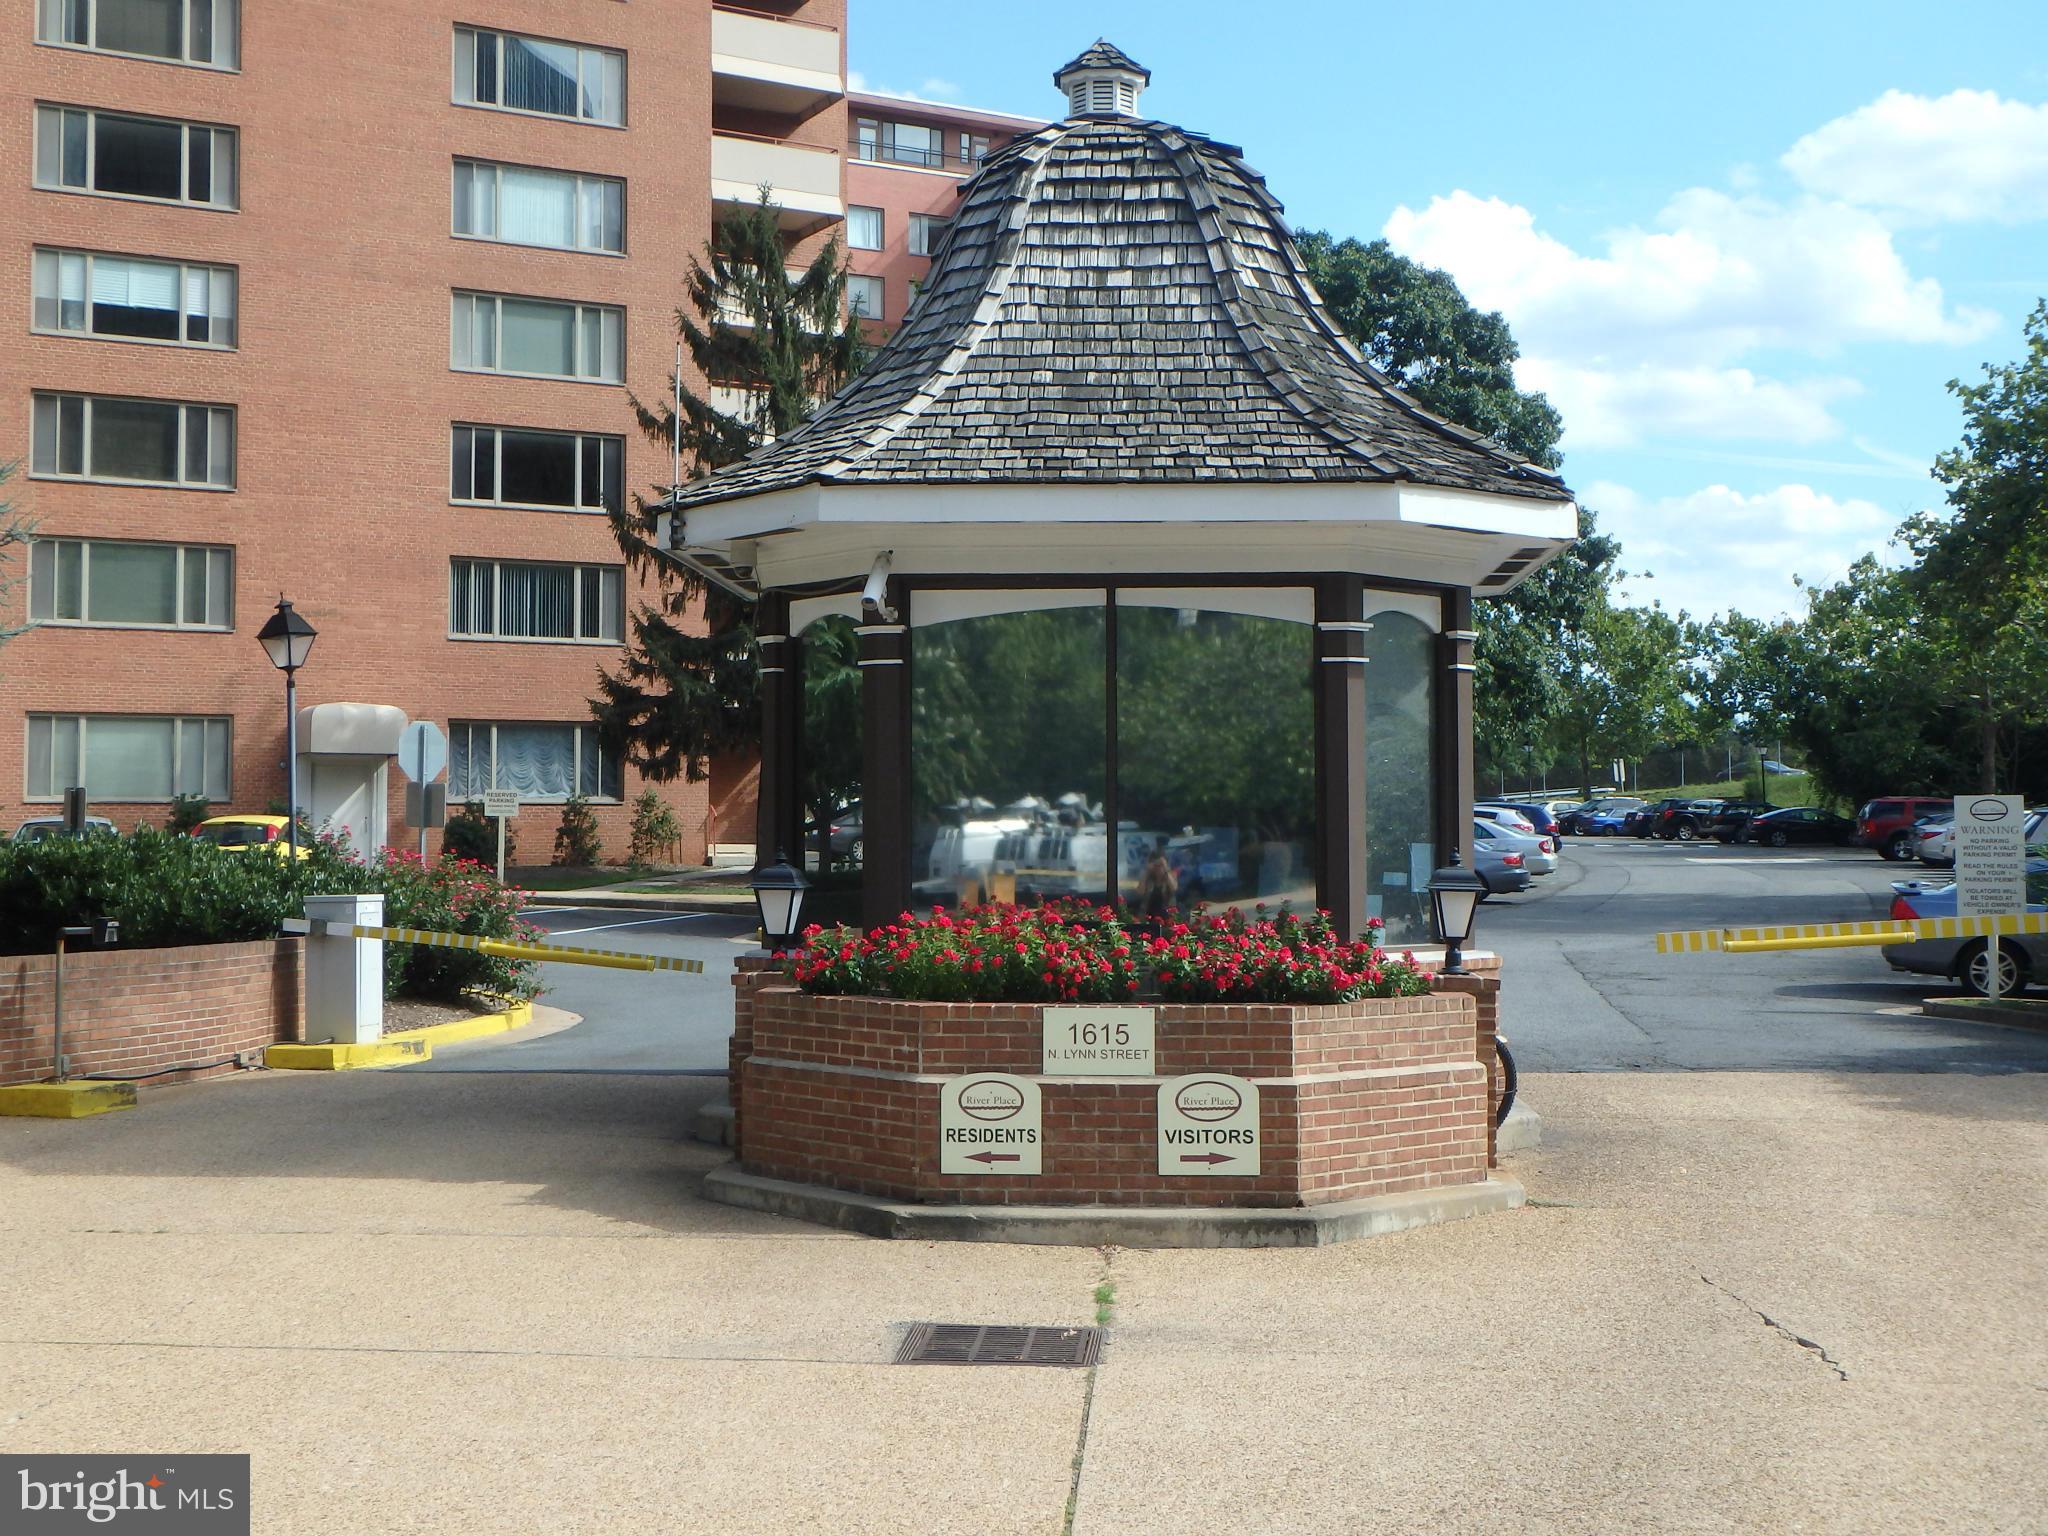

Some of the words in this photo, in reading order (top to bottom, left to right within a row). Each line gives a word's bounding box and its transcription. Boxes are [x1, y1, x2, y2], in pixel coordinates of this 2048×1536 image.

[1960, 825, 2020, 835] WARNING
[1068, 1023, 1130, 1045] 1615
[1048, 1049, 1060, 1060] N.
[1064, 1049, 1097, 1060] LYNN
[1100, 1049, 1150, 1060] STREET
[966, 1095, 991, 1105] River
[993, 1095, 1017, 1105] Place
[1183, 1096, 1208, 1106] River
[1210, 1096, 1234, 1106] Place
[946, 1128, 1037, 1144] RESIDENTS
[1164, 1129, 1254, 1144] VISITORS
